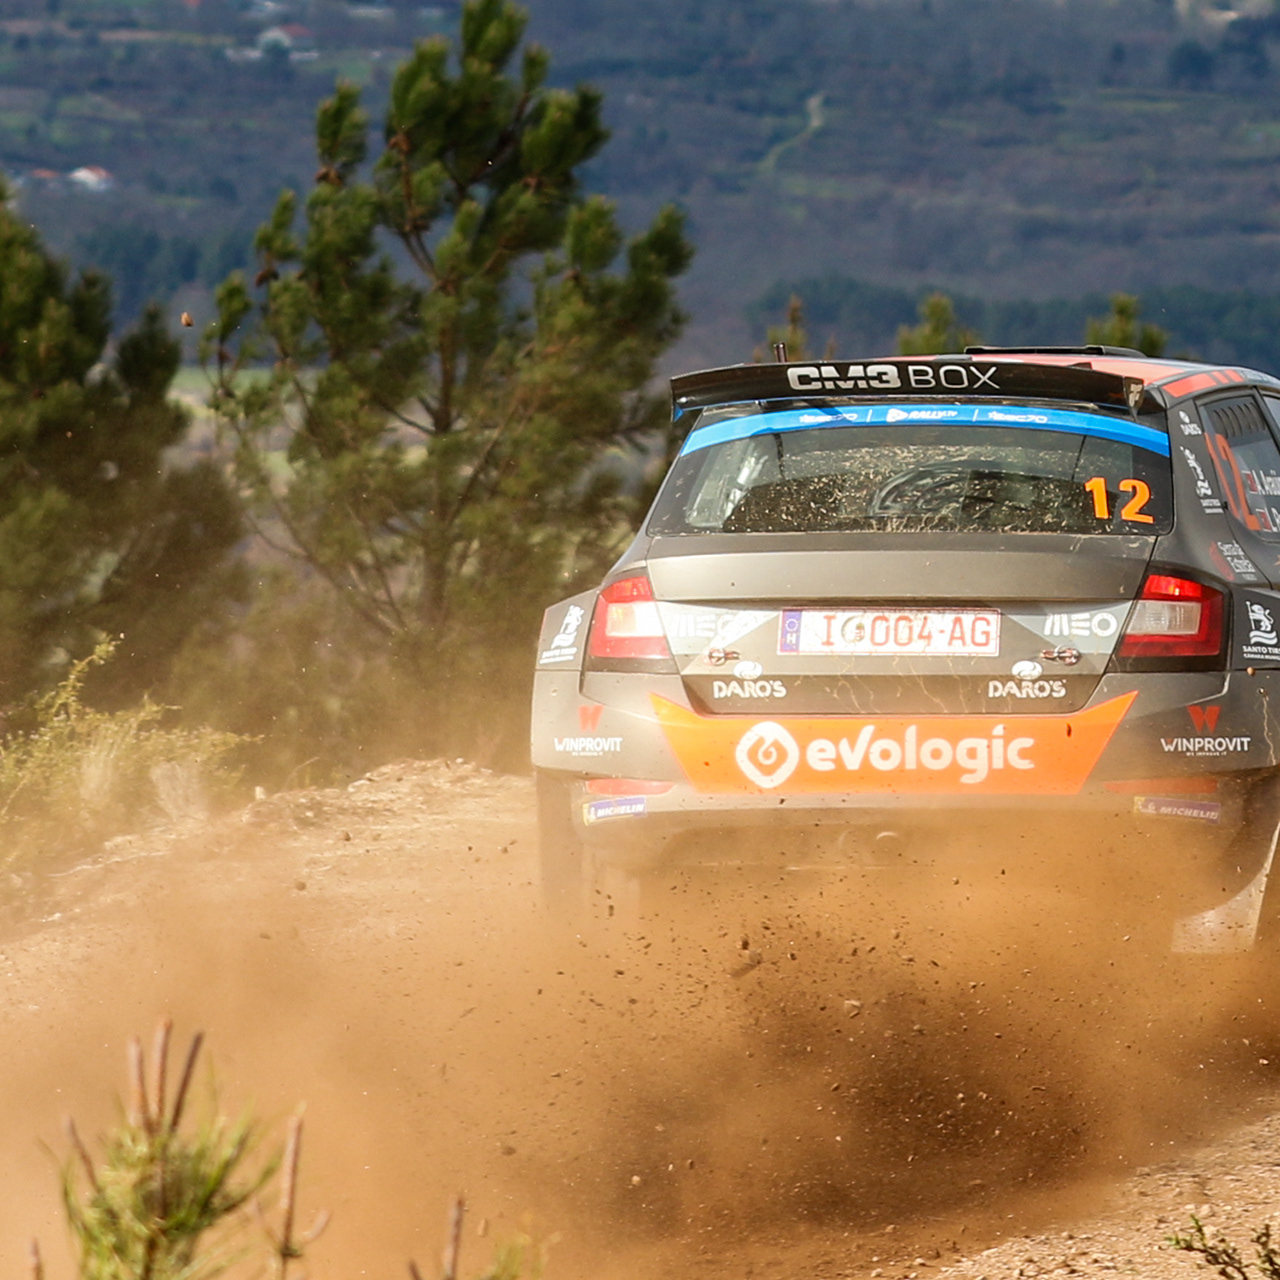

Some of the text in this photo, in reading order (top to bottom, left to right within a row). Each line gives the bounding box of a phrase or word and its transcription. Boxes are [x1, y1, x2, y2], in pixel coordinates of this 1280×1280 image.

[786, 365, 1001, 390] CM3 BOX
[1084, 477, 1154, 524] 12
[1044, 612, 1118, 637] MEO
[1242, 645, 1268, 654] SANTO
[713, 680, 787, 699] DARO'S
[988, 680, 1067, 699] DARO'S
[554, 737, 623, 752] WINPROVIT
[1160, 737, 1252, 752] WINPROVIT
[596, 803, 646, 819] MICHELIN
[1160, 807, 1220, 820] MICHELIN
